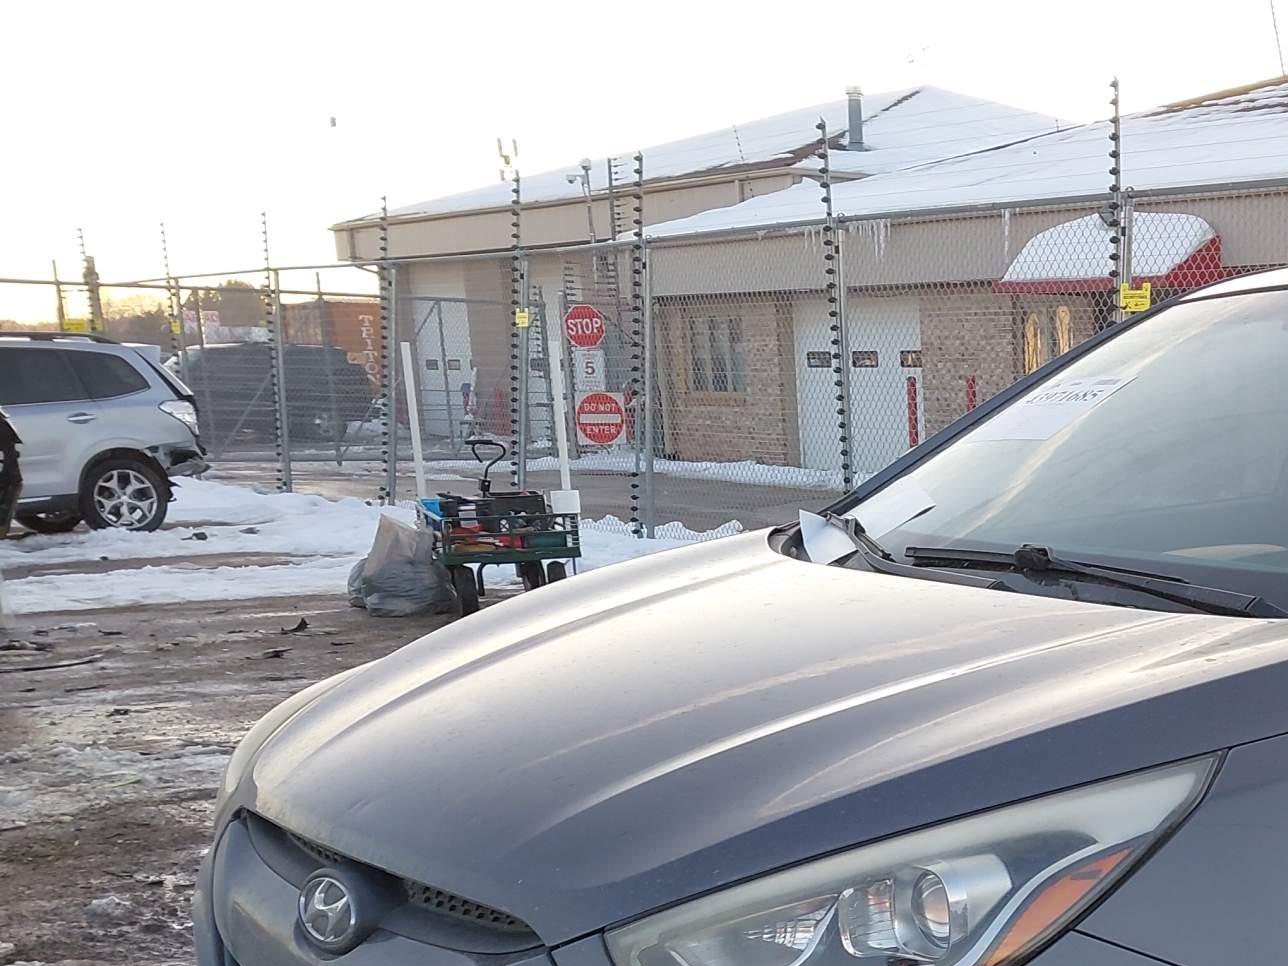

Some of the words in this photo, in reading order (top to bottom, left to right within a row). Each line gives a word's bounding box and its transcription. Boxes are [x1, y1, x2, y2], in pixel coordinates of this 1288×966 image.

[567, 318, 601, 336] STOP
[584, 361, 596, 376] 5
[584, 403, 596, 412] DO
[600, 403, 617, 412] NOT
[586, 424, 617, 435] ENTER
